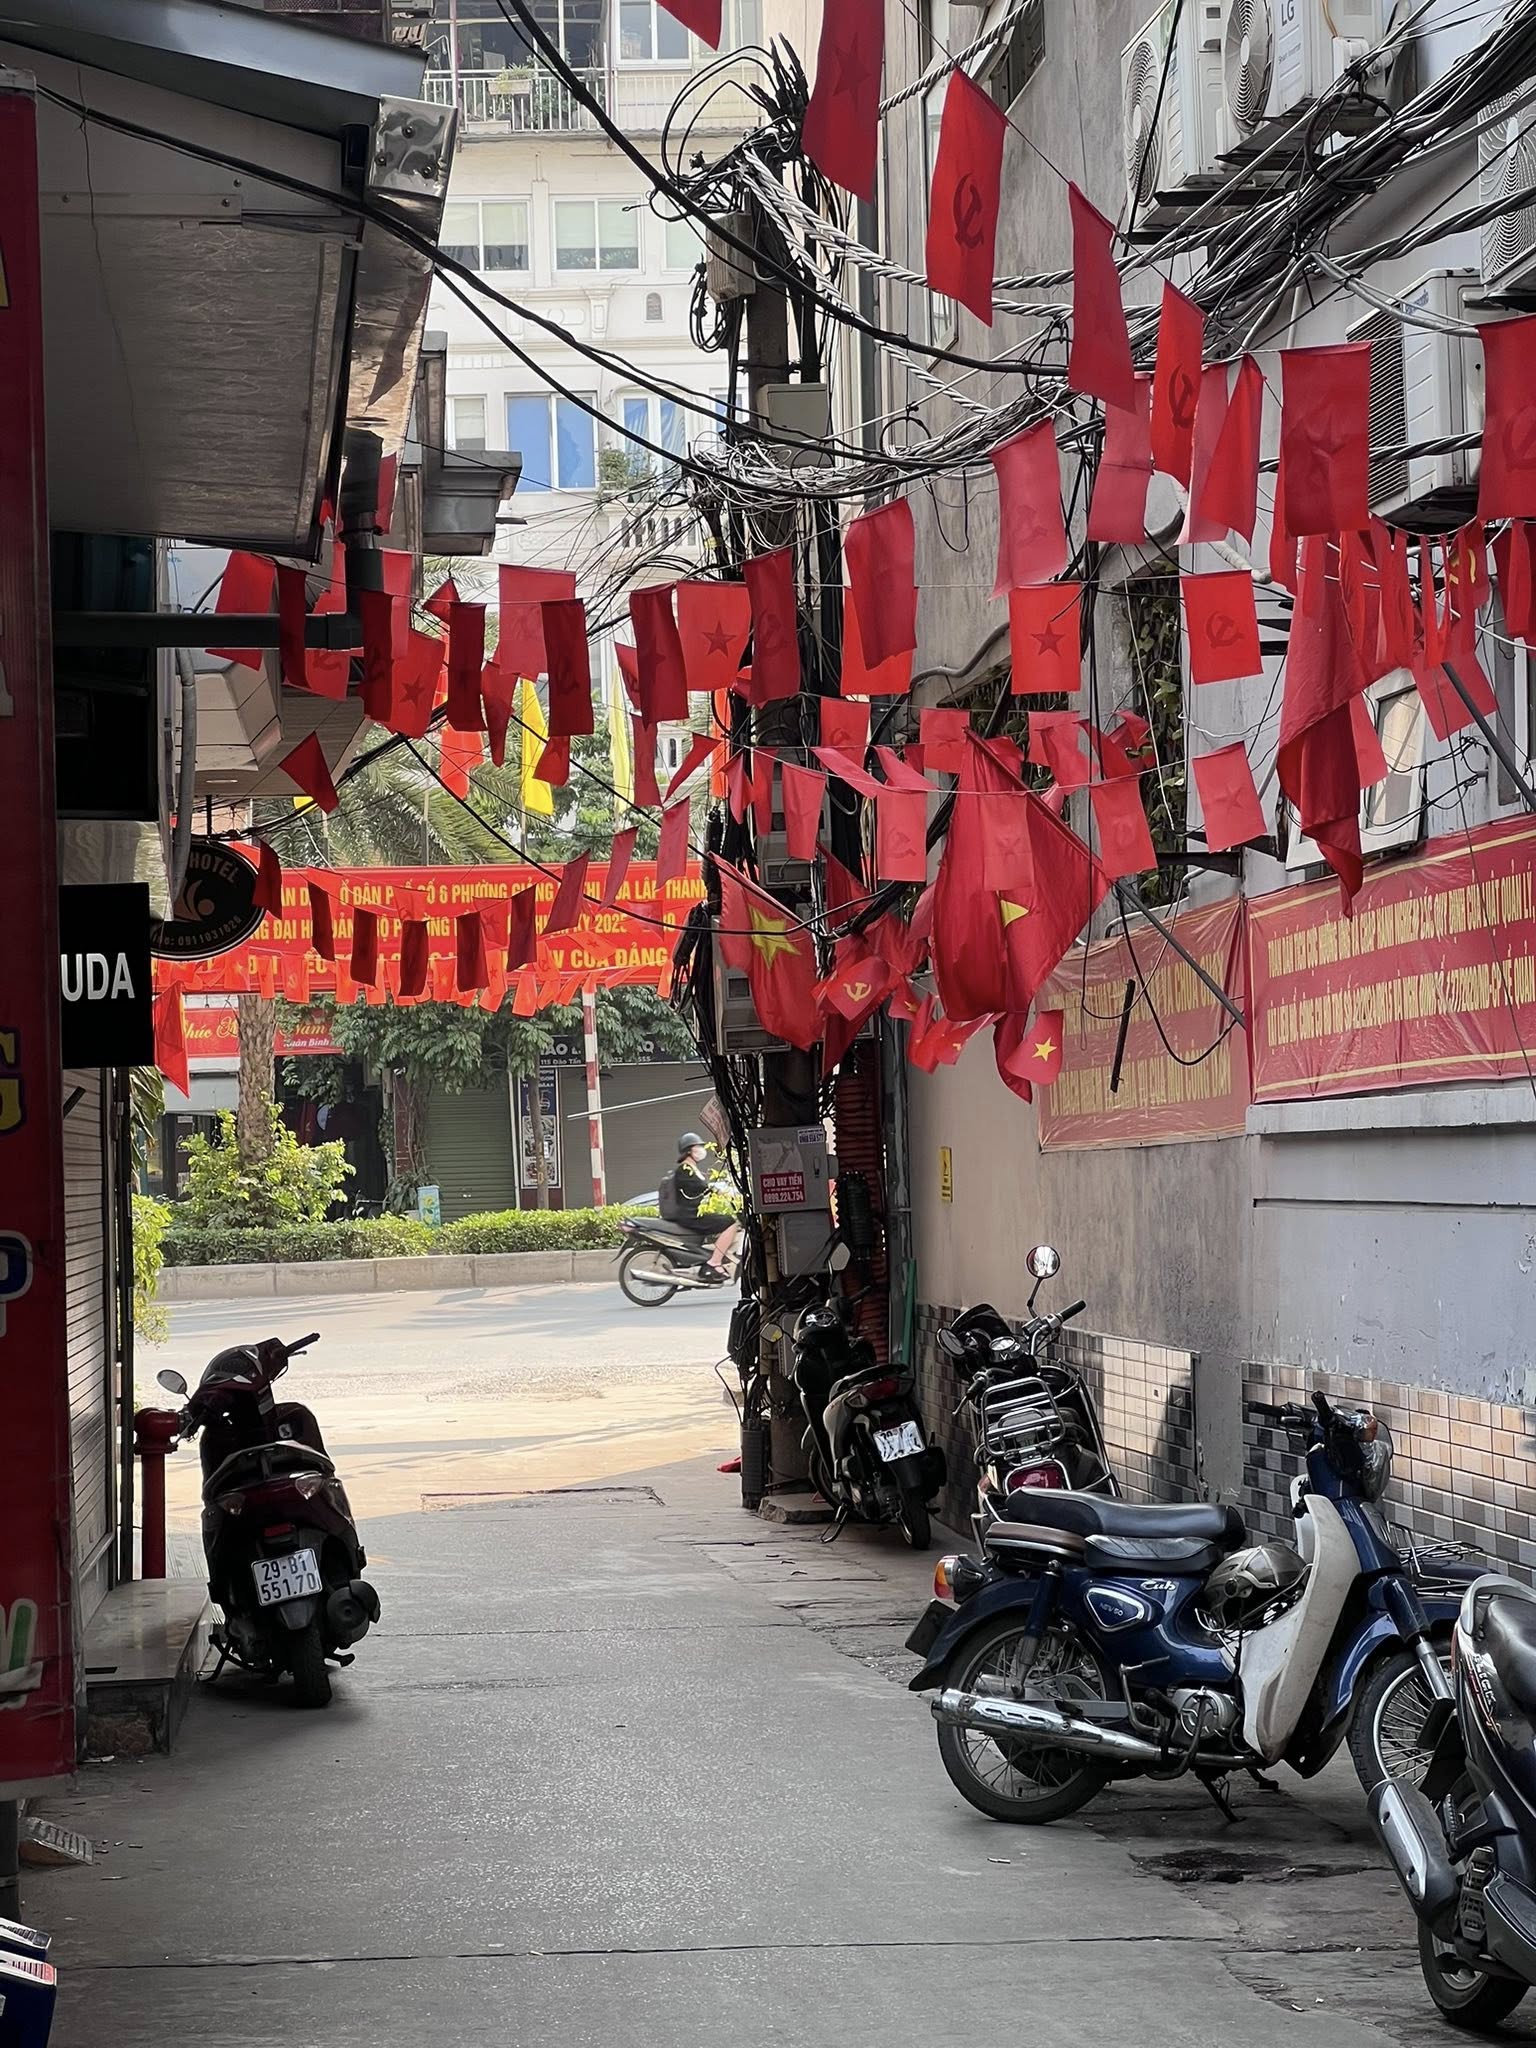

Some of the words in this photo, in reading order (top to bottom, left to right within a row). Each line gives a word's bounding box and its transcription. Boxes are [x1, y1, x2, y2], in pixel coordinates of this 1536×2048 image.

[1281, 0, 1295, 26] LG
[189, 851, 239, 883] HOTEL
[439, 886, 448, 904] 6
[273, 920, 297, 945] ĐẠI
[615, 941, 668, 968] ĐẢNG
[60, 952, 136, 1002] UDA
[262, 1554, 307, 1581] 29-B1
[261, 1573, 317, 1601] 551.70
